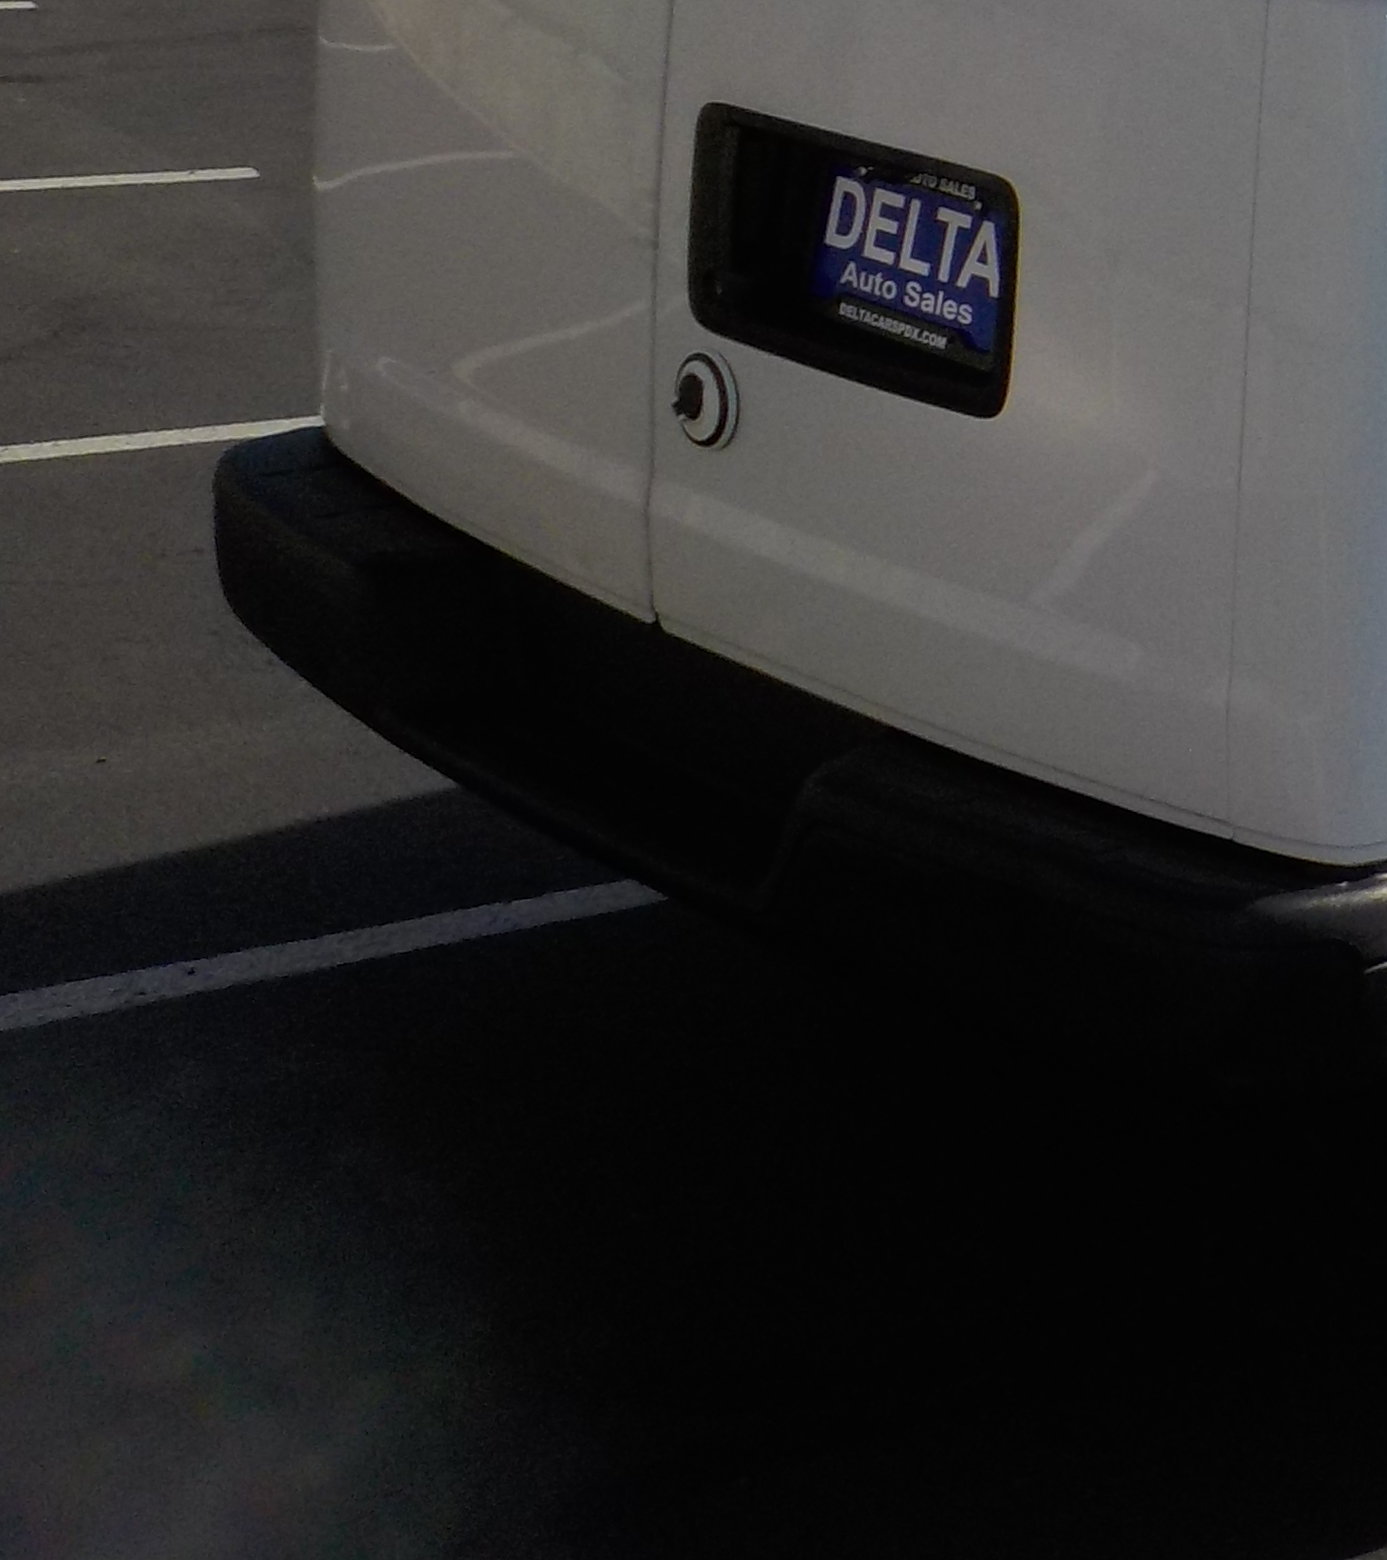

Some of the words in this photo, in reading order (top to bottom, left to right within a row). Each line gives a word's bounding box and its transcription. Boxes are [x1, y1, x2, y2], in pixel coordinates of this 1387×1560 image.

[941, 177, 977, 200] SALES
[823, 175, 1001, 299] DELTA
[839, 260, 898, 300] Auto
[903, 280, 973, 325] Sales
